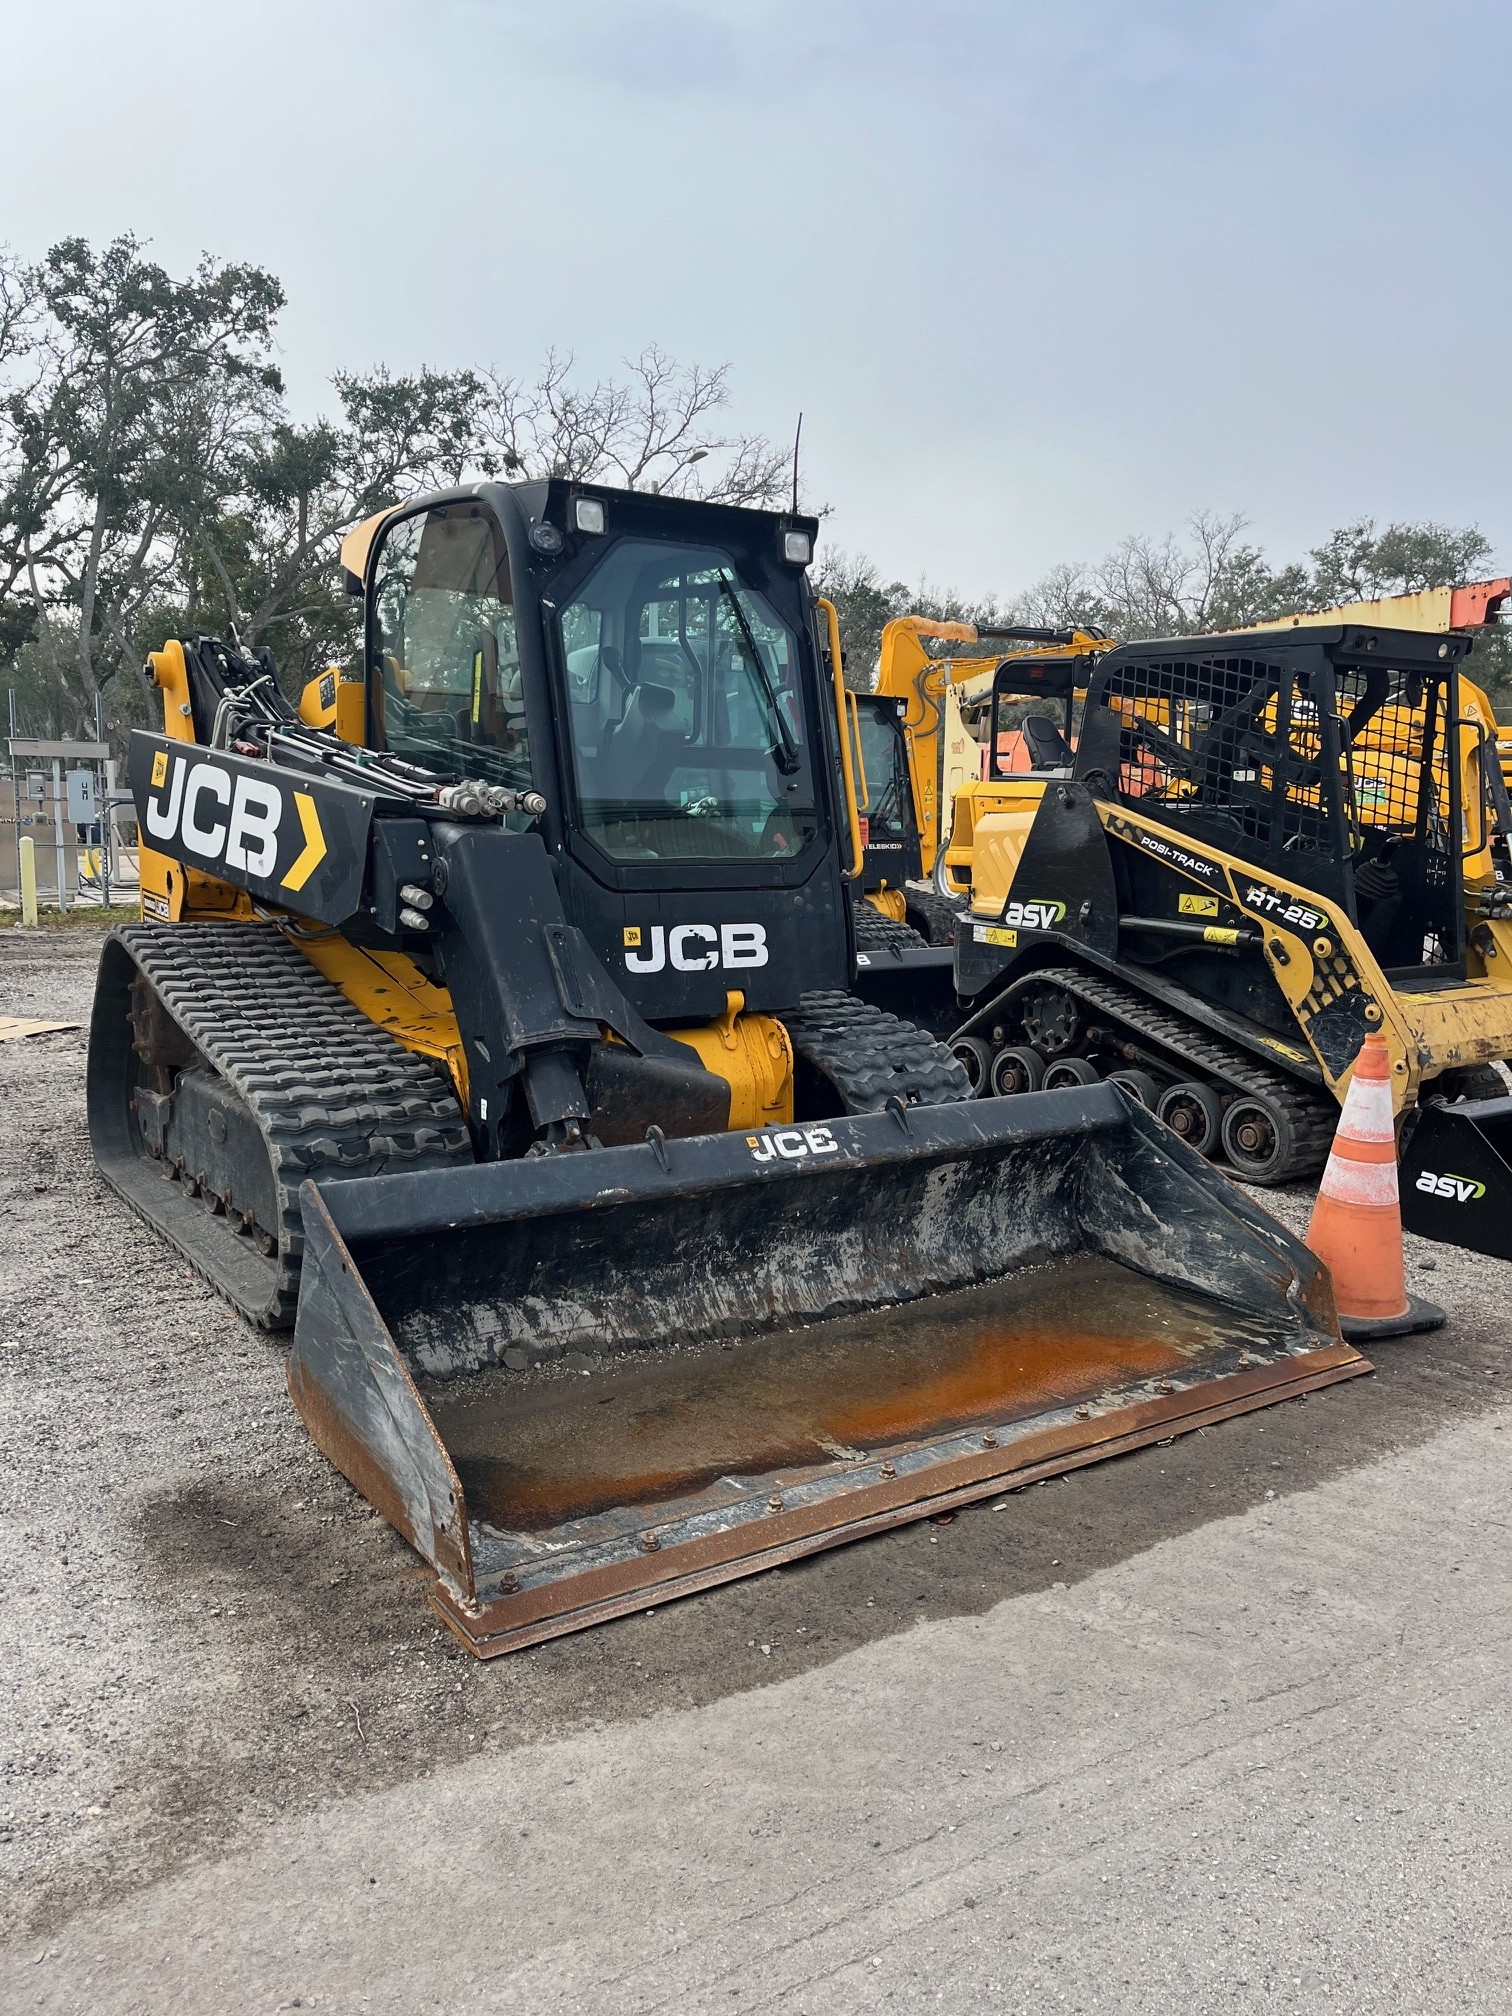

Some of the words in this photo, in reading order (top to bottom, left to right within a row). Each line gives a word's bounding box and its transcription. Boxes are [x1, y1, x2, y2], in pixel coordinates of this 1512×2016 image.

[146, 757, 283, 878] JCB
[1141, 836, 1213, 877] POSI-TRACK
[1246, 888, 1319, 930] RT-25
[625, 923, 769, 973] JCB
